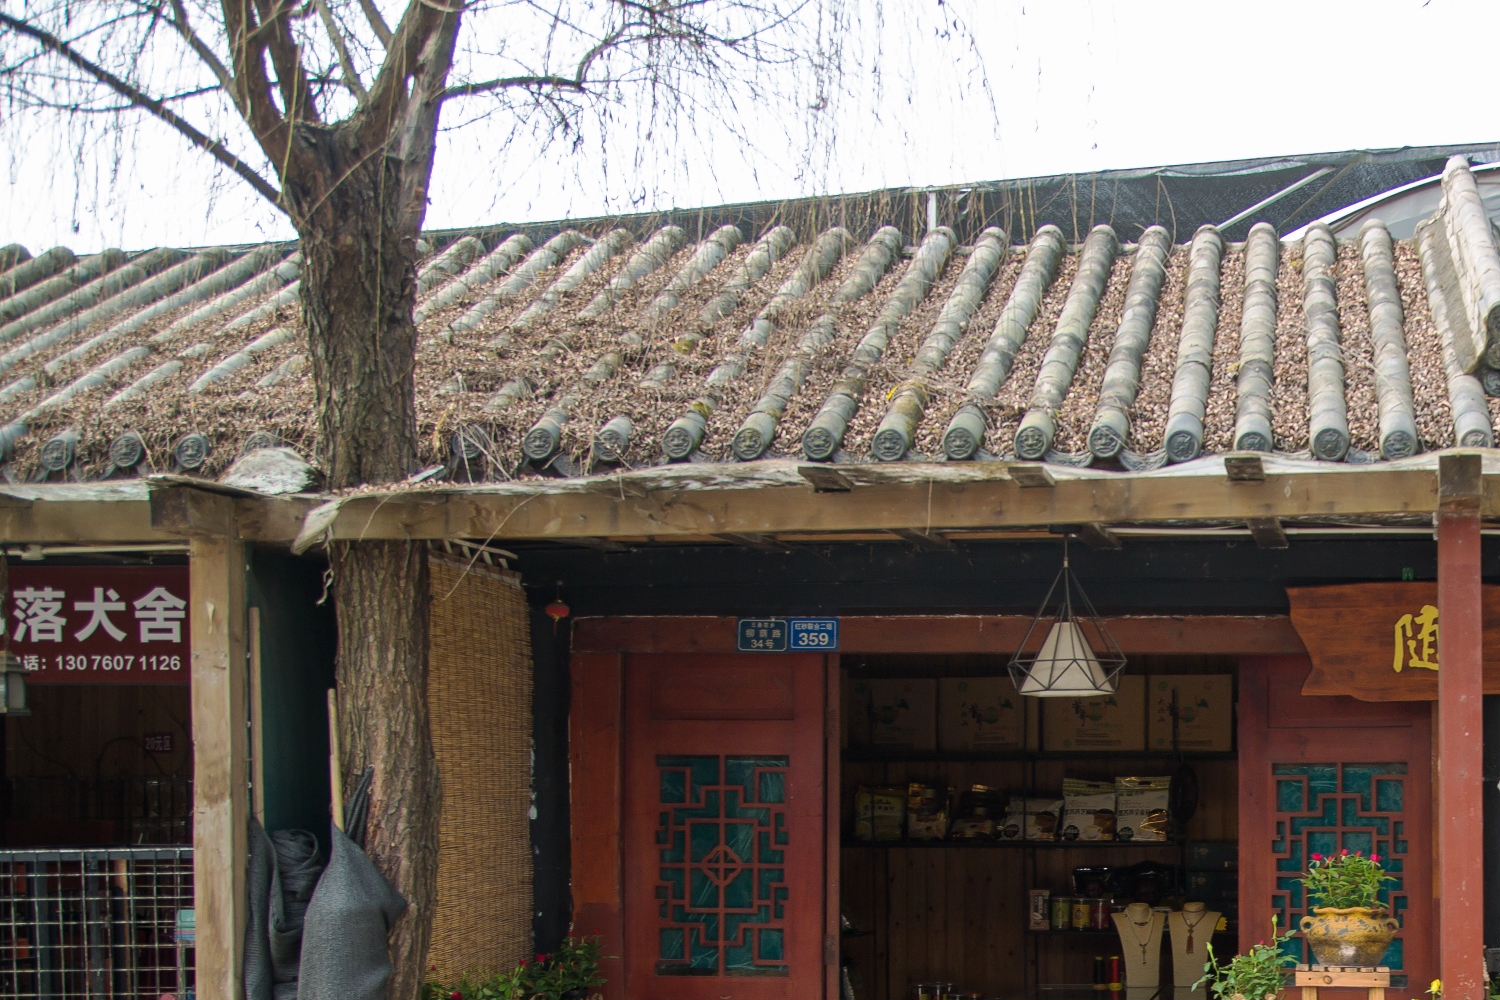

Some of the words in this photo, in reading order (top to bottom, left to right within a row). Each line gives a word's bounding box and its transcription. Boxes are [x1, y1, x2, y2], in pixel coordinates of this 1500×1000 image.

[0, 586, 187, 643] 落犬舍
[751, 639, 774, 649] 34号
[798, 632, 829, 646] 359
[15, 654, 47, 671] 话：
[55, 655, 87, 671] 130
[91, 655, 135, 671] 7607
[139, 655, 181, 671] 1126
